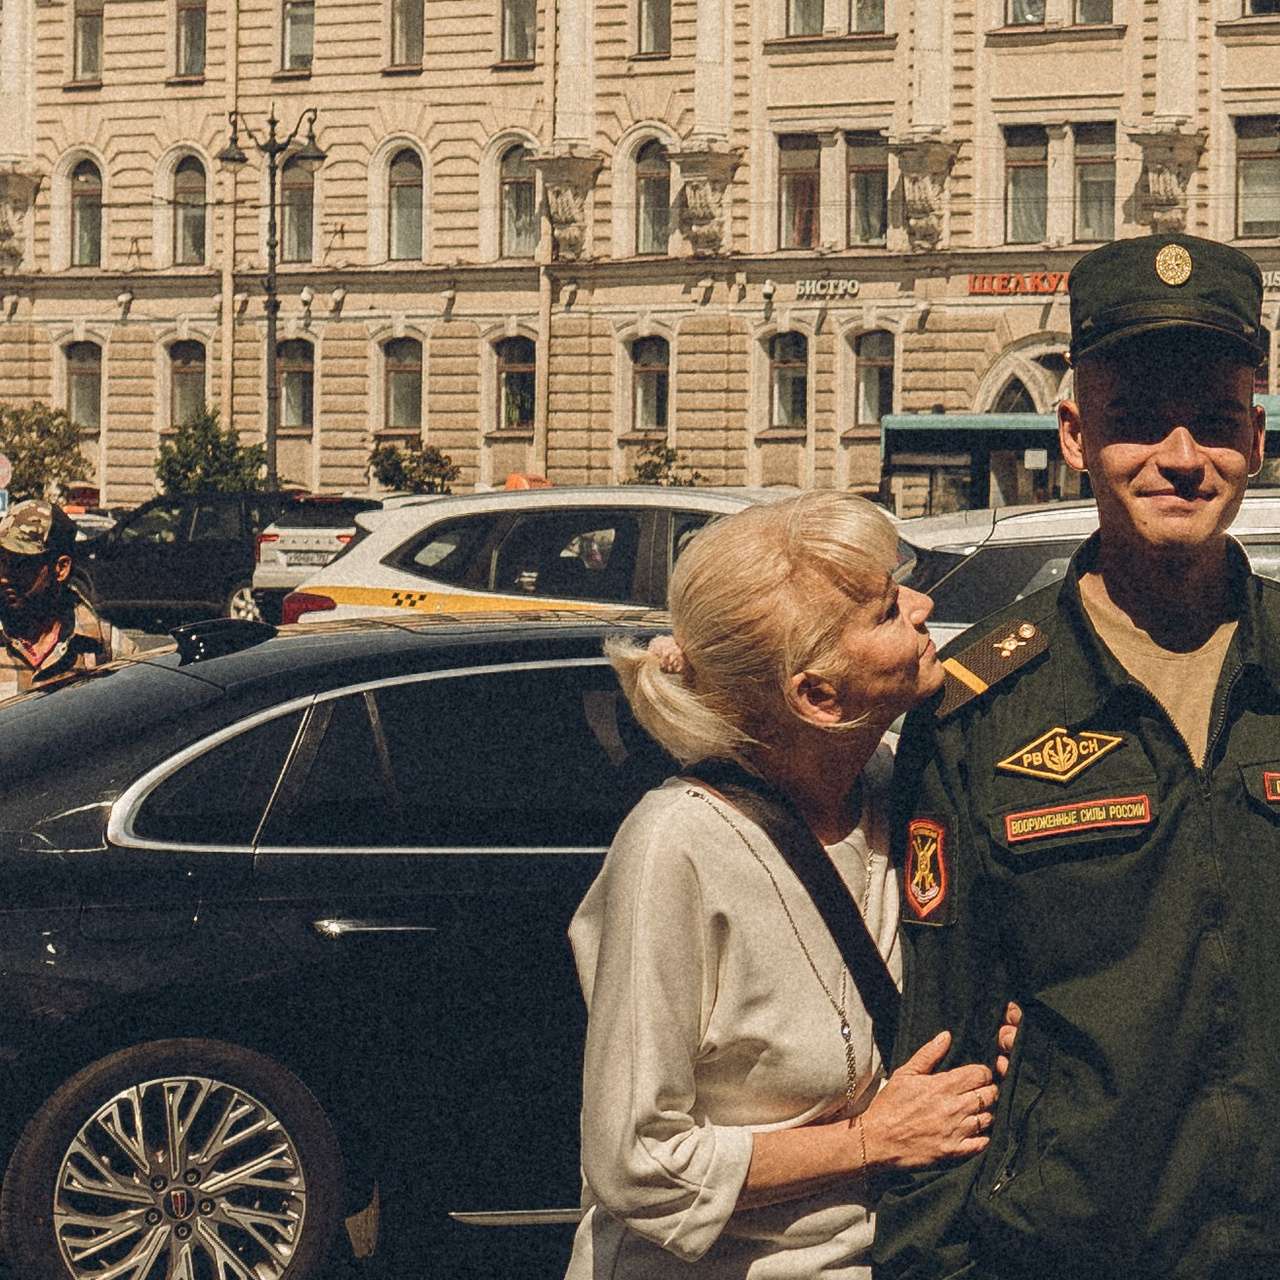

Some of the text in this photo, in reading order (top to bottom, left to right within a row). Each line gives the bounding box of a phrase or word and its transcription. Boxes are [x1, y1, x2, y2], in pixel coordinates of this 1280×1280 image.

[796, 280, 859, 297] БИСТРО
[968, 272, 1069, 294] ЩЕЛКУ
[1022, 738, 1099, 767] РВ СН
[1011, 802, 1146, 834] ВООРУЖЕННЫЕ СИЛЫ РОССИИ
